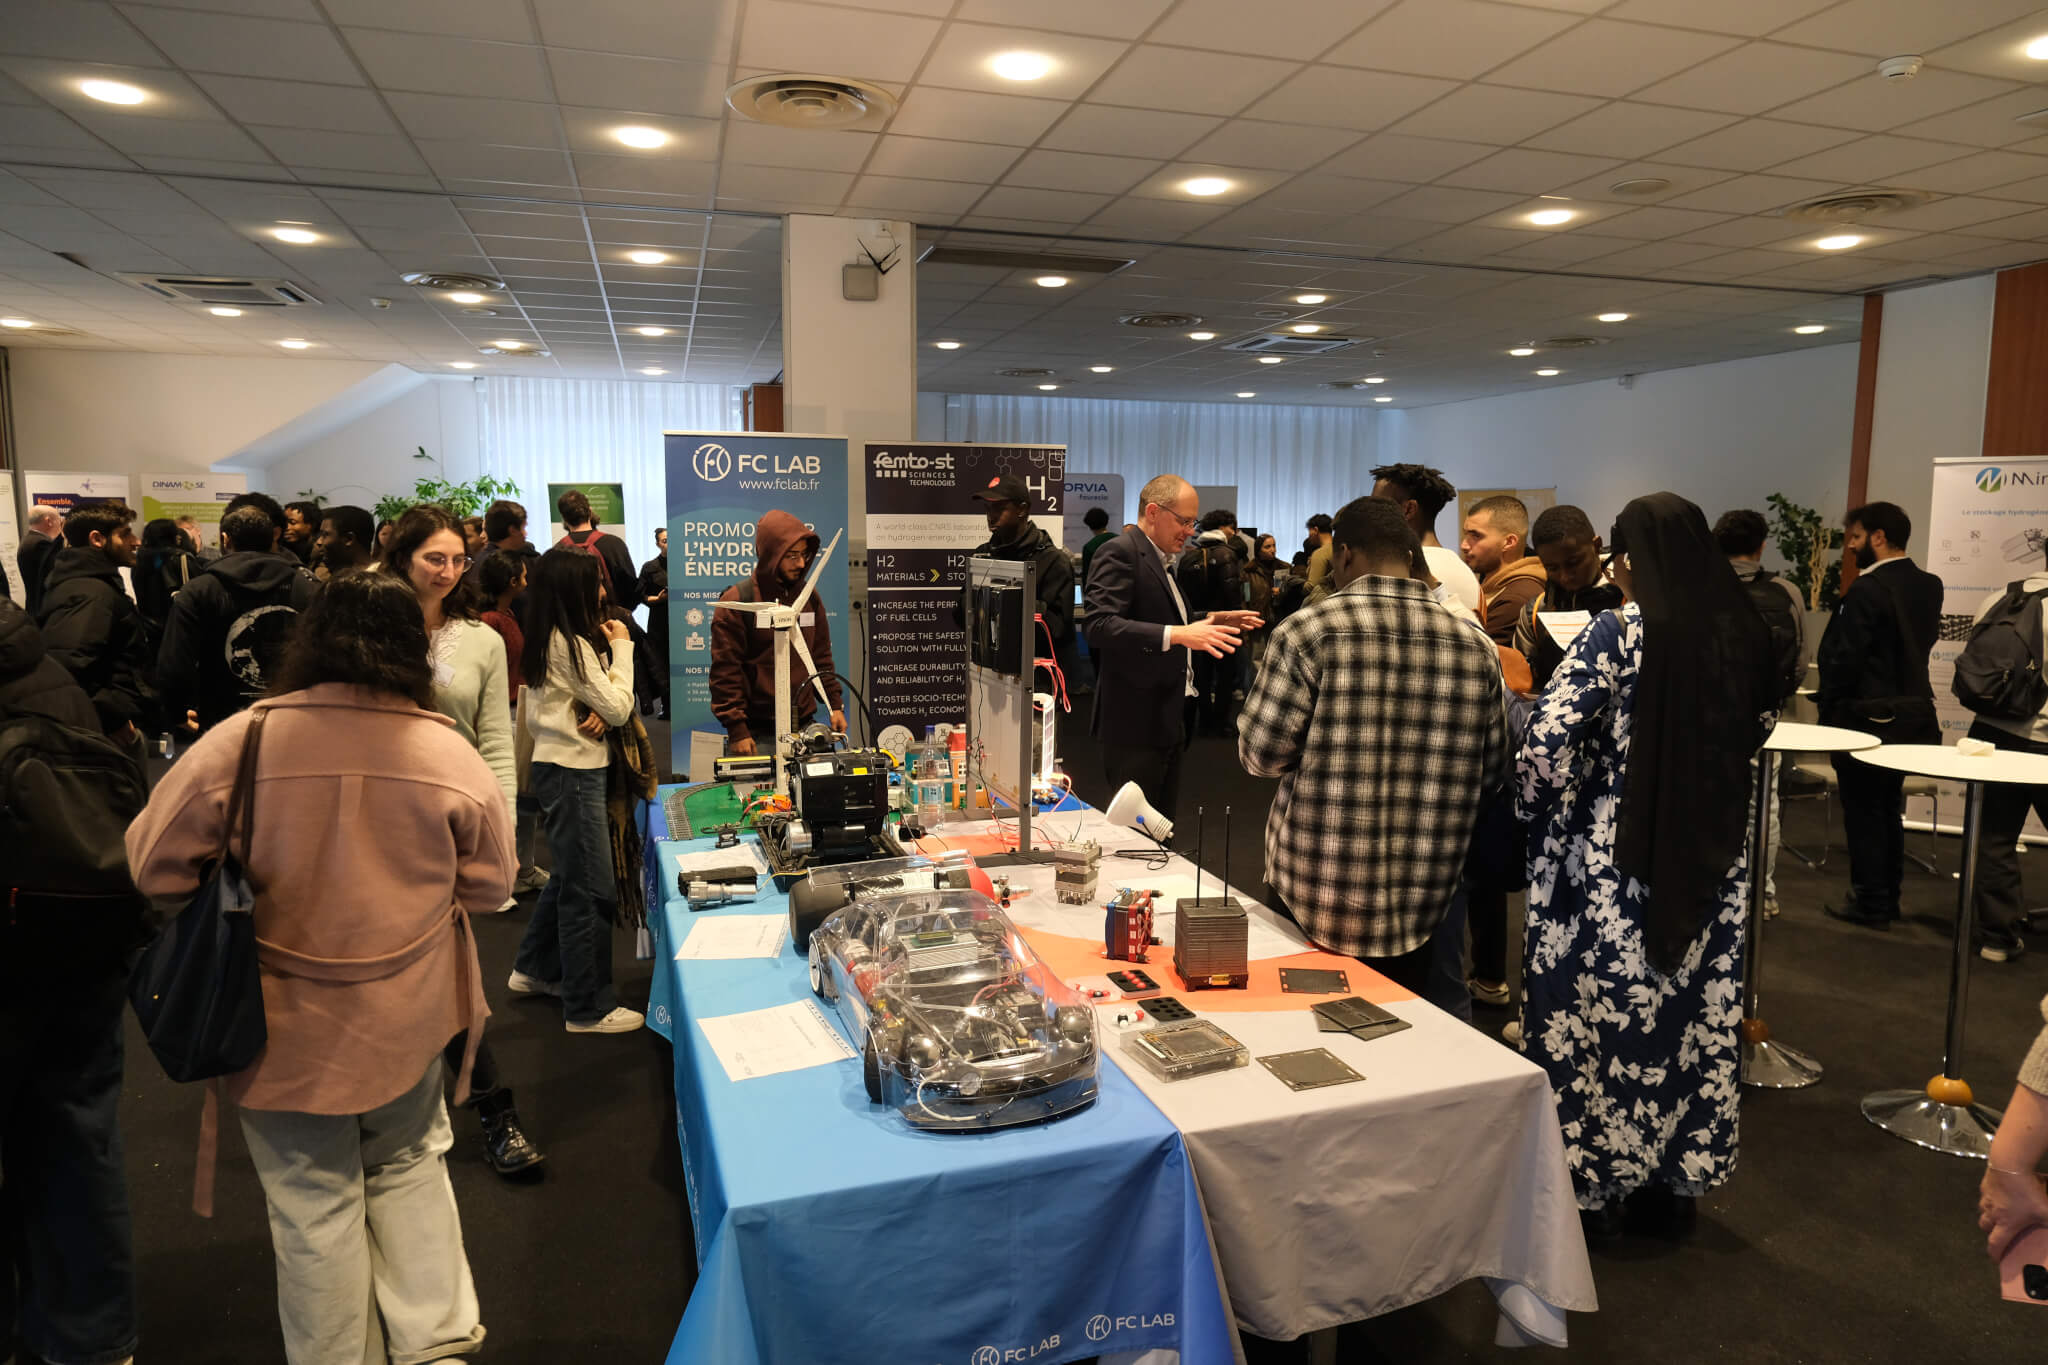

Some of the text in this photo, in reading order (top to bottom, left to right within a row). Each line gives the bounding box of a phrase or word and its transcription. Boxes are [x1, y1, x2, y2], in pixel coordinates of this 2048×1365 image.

[738, 454, 821, 475] FC LAB
[873, 451, 955, 470] femto-st
[908, 471, 956, 479] SCIENCES &
[739, 477, 821, 491] www.fclab.fr
[909, 479, 956, 487] TECHNOLOGIES
[1063, 482, 1108, 493] ORVIA
[876, 555, 895, 568] H2
[947, 554, 966, 567] H2
[876, 572, 926, 582] MATERIALS
[947, 572, 966, 581] STO
[683, 591, 701, 599] NOS
[877, 601, 918, 609] INCREASE
[920, 601, 935, 609] THE
[875, 613, 937, 622] OF FUEL CELLS
[878, 632, 965, 641] PROPOSE THE SAFEST
[876, 645, 919, 653] SOLUTION
[921, 644, 942, 652] WITH
[685, 666, 703, 675] NOS
[878, 664, 918, 672] INCREASE
[876, 676, 894, 685] AND
[895, 675, 941, 684] RELIABILITY
[942, 674, 954, 683] OF
[879, 695, 911, 704] FOSTER
[877, 707, 917, 716] TOWARDS
[929, 704, 967, 714] ECONOM
[1116, 1313, 1175, 1331] FC LAB
[1005, 1334, 1061, 1363] FC LAB
